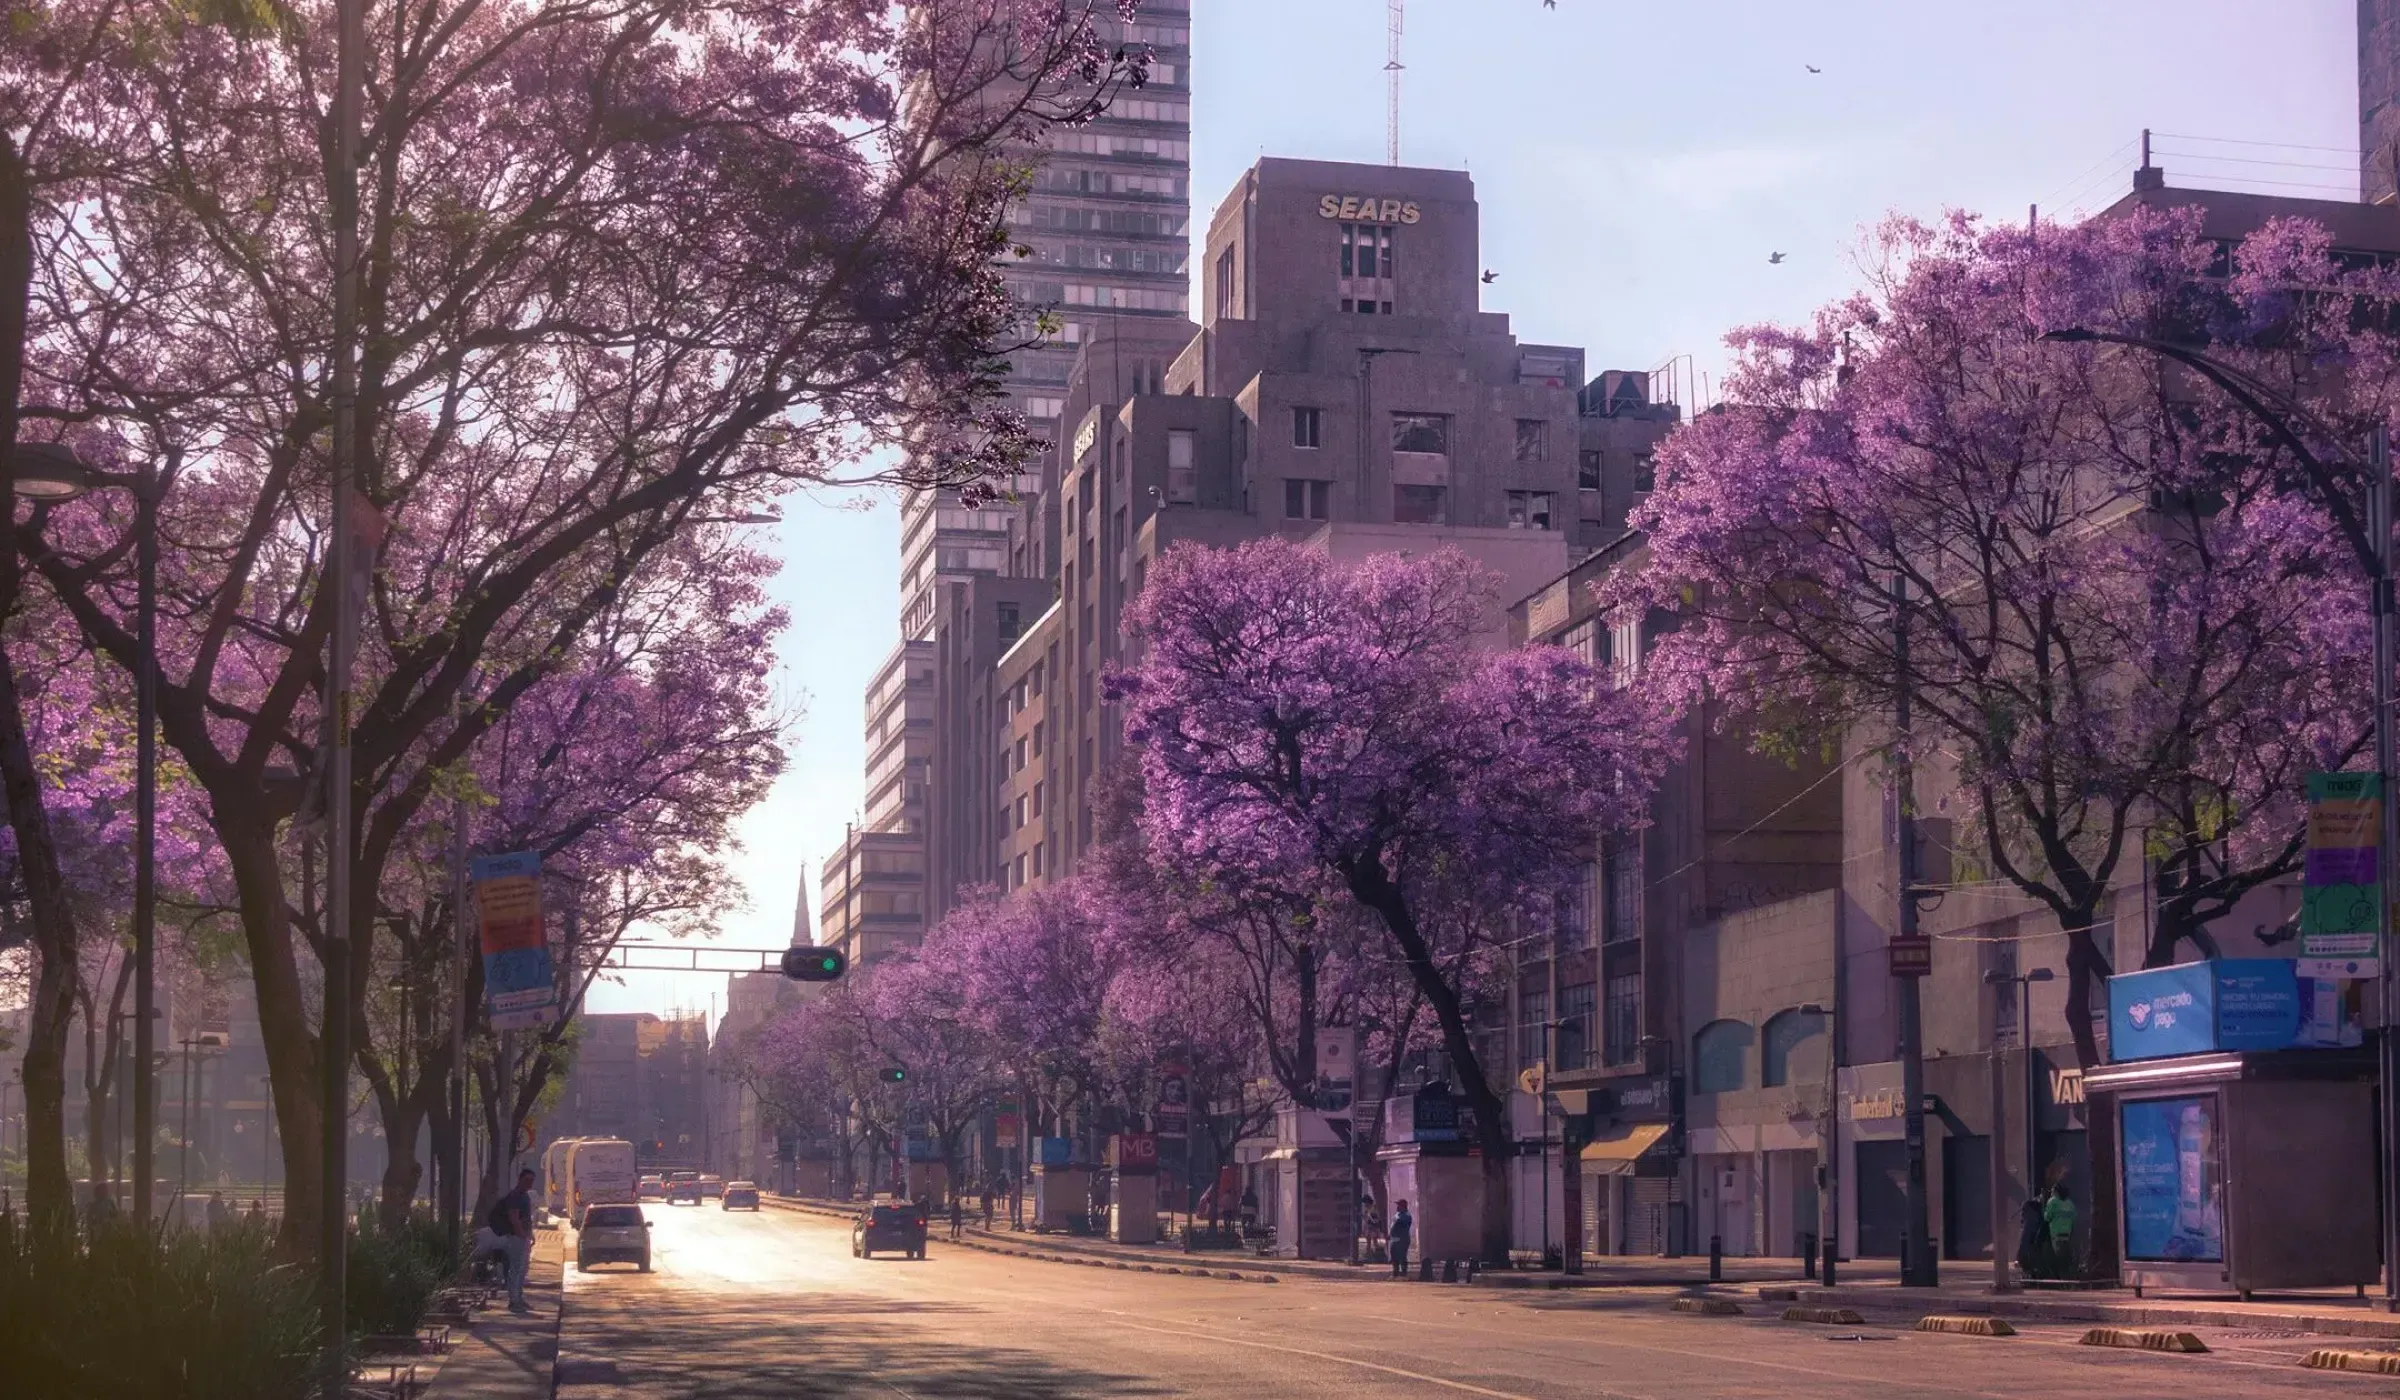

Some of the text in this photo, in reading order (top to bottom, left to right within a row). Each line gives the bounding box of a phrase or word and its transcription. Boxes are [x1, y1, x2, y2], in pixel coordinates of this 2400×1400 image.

[1319, 194, 1420, 224] SEARS
[2153, 991, 2193, 1010] mercado
[2154, 1012, 2176, 1030] pago
[2049, 1069, 2086, 1104] VAN
[1848, 1093, 1894, 1121] Timberland
